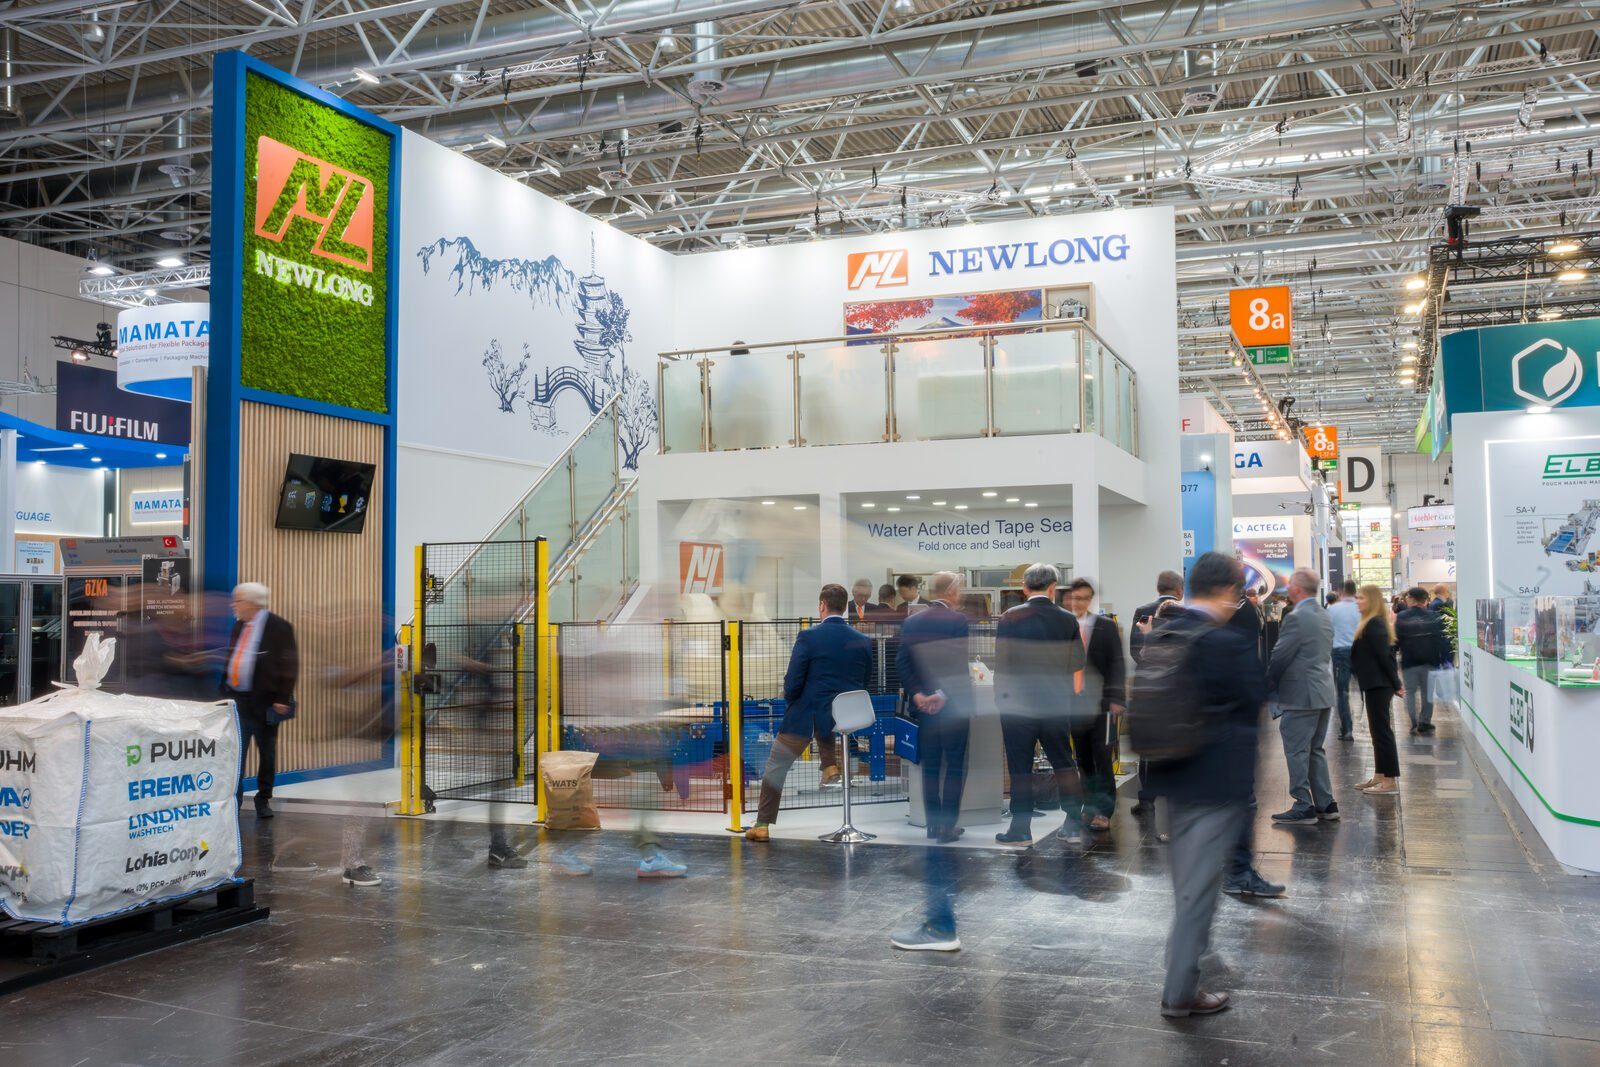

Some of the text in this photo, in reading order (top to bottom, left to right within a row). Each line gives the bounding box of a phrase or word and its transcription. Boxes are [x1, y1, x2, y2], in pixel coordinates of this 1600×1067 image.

[929, 234, 1131, 276] NEWLONG
[255, 249, 375, 307] NEWLONG
[1248, 297, 1285, 331] 8a
[119, 320, 210, 345] MAMATA
[1234, 452, 1263, 469] GA
[1347, 456, 1375, 493] D
[134, 498, 182, 511] MAMATA
[1516, 506, 1536, 514] SA-V
[868, 523, 914, 538] Water
[917, 520, 990, 537] Activated
[995, 519, 1035, 538] Tape
[1247, 523, 1287, 532] ACTEGA
[918, 538, 1041, 551] Fold once and Seal tight
[1519, 586, 1540, 594] SA-U
[151, 739, 216, 763] PUHM
[128, 774, 195, 801] EREMA
[552, 780, 578, 788] WATS
[128, 803, 211, 830] LINDNER
[129, 824, 174, 840] WASHTECH
[125, 845, 199, 873] Lohia Corp
